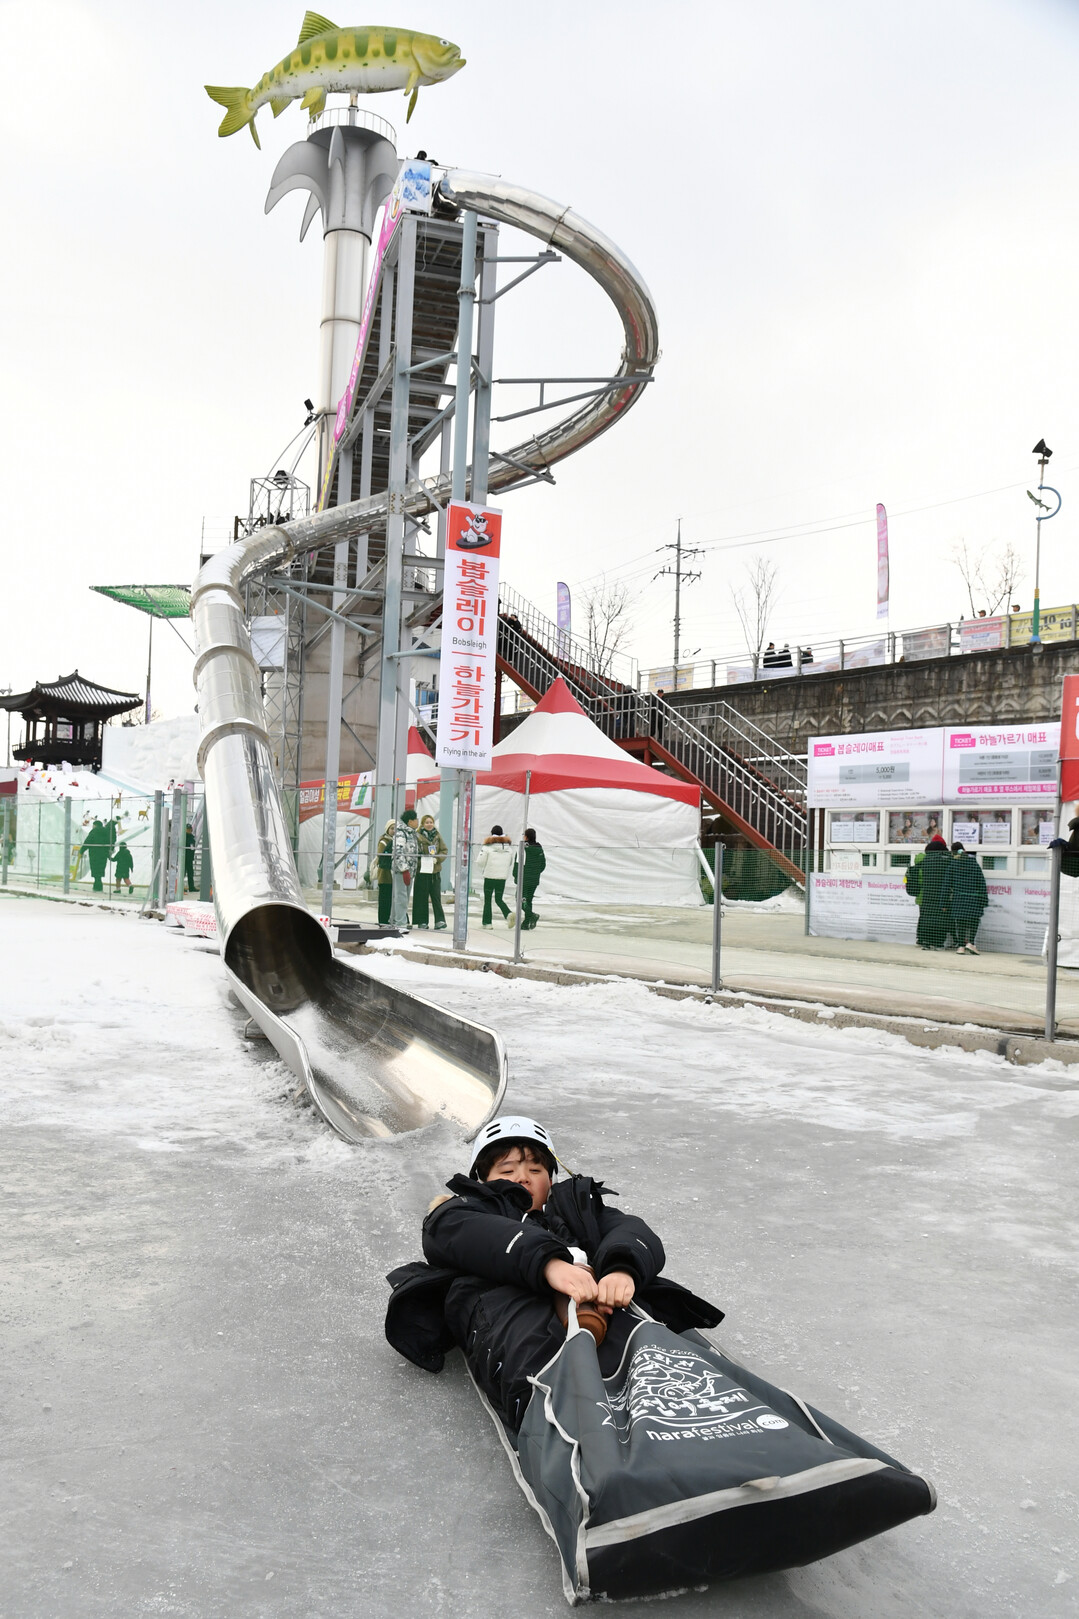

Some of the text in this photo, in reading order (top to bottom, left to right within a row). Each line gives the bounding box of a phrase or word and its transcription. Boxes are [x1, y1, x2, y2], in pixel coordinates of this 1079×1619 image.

[455, 558, 490, 636] 봅슬레이
[452, 637, 487, 650] Bobsleigh
[449, 665, 486, 746] 하늘가르기
[979, 731, 1047, 746] 하늘가르기 매표
[443, 747, 461, 757] Flying
[837, 741, 885, 755] 봅슬레이매표
[815, 878, 838, 888] 봅슬레이
[697, 1392, 749, 1413] 축제
[646, 1419, 759, 1441] narafestival
